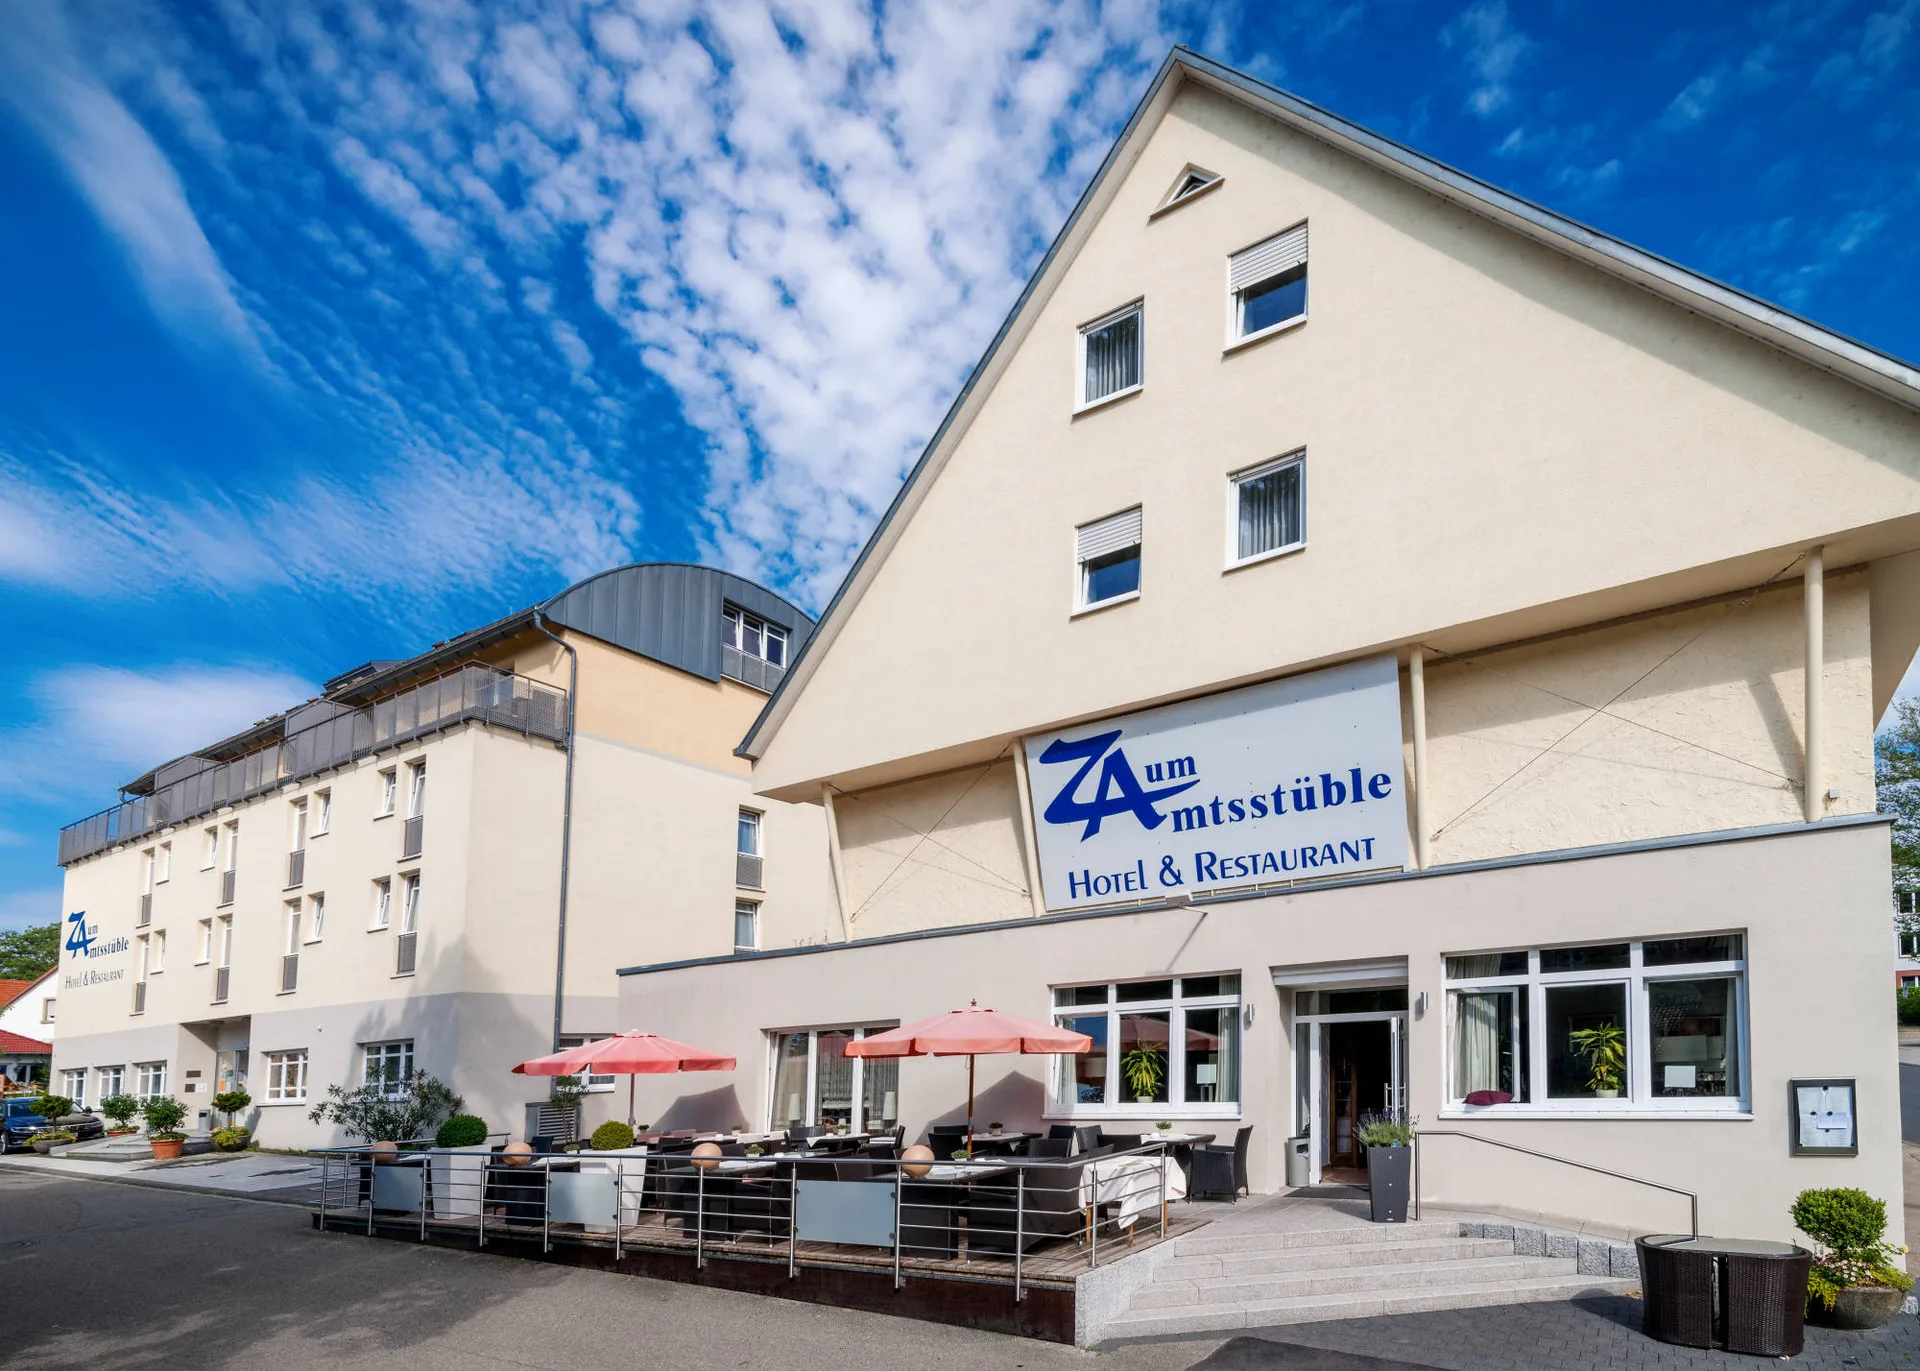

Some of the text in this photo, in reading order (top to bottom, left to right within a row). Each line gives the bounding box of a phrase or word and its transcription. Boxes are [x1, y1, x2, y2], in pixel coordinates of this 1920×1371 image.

[1080, 747, 1392, 842] Amtsstüble
[1159, 855, 1184, 887] &
[83, 971, 89, 986] &
